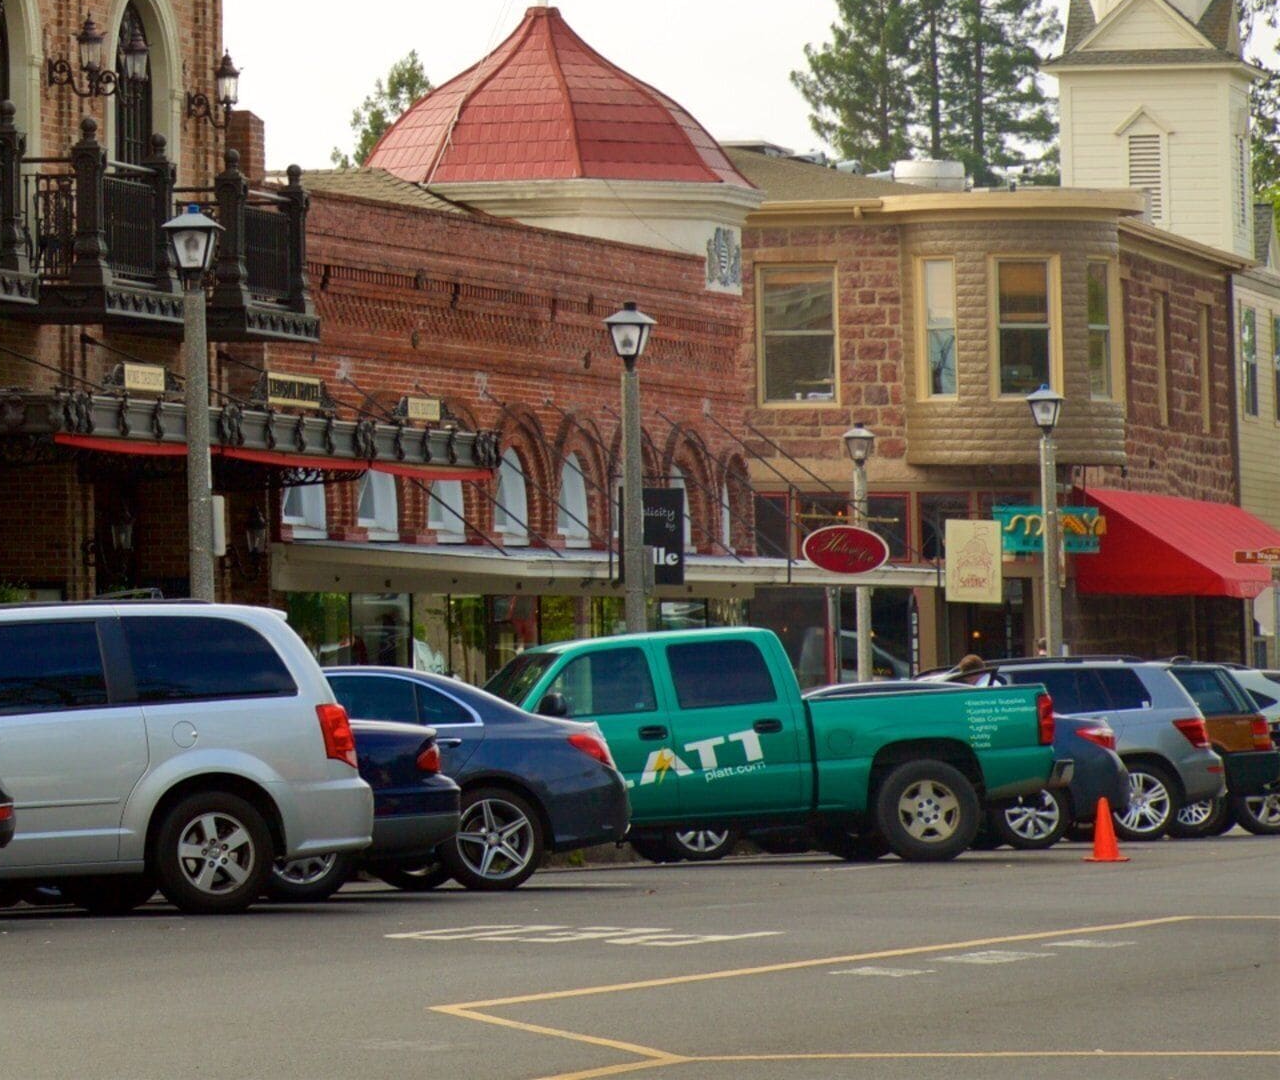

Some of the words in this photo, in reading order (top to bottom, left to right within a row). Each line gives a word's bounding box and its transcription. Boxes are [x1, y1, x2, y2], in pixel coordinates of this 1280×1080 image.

[643, 506, 675, 522] licity
[625, 728, 764, 788] ATT
[704, 761, 766, 783] platt.com
